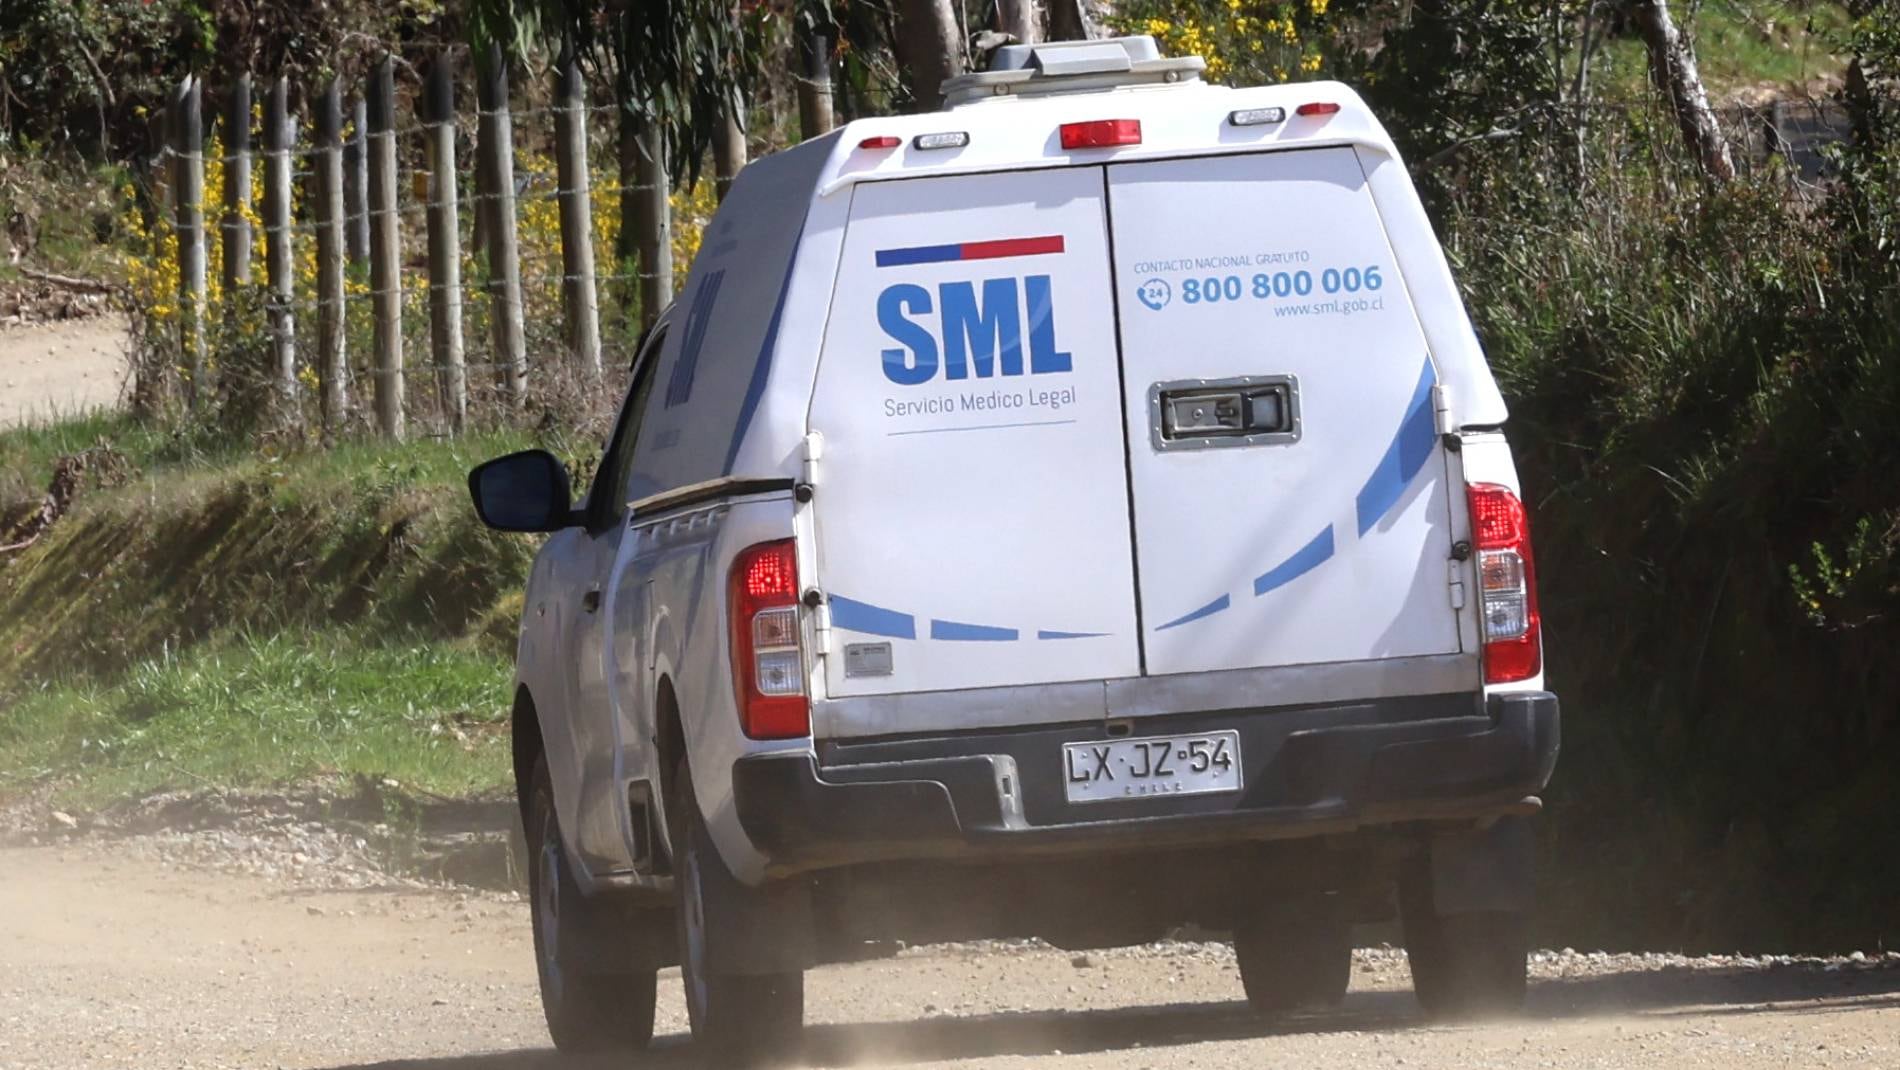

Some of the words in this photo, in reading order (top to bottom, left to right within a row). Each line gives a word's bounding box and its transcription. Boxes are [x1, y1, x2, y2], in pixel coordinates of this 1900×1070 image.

[1134, 260, 1193, 273] CONTACTO
[1195, 255, 1252, 270] NACIONAL
[1256, 251, 1309, 265] GRATUITO
[1149, 289, 1163, 298] 24
[1182, 276, 1242, 304] 800
[1252, 270, 1312, 299] 800
[1322, 266, 1382, 294] 006
[1274, 297, 1384, 317] www.sml.gob.cl
[876, 274, 1073, 385] SML
[884, 398, 954, 417] Servicio
[960, 390, 1023, 411] Medico
[1029, 386, 1076, 409] Legal
[1125, 782, 1183, 794] CHILE
